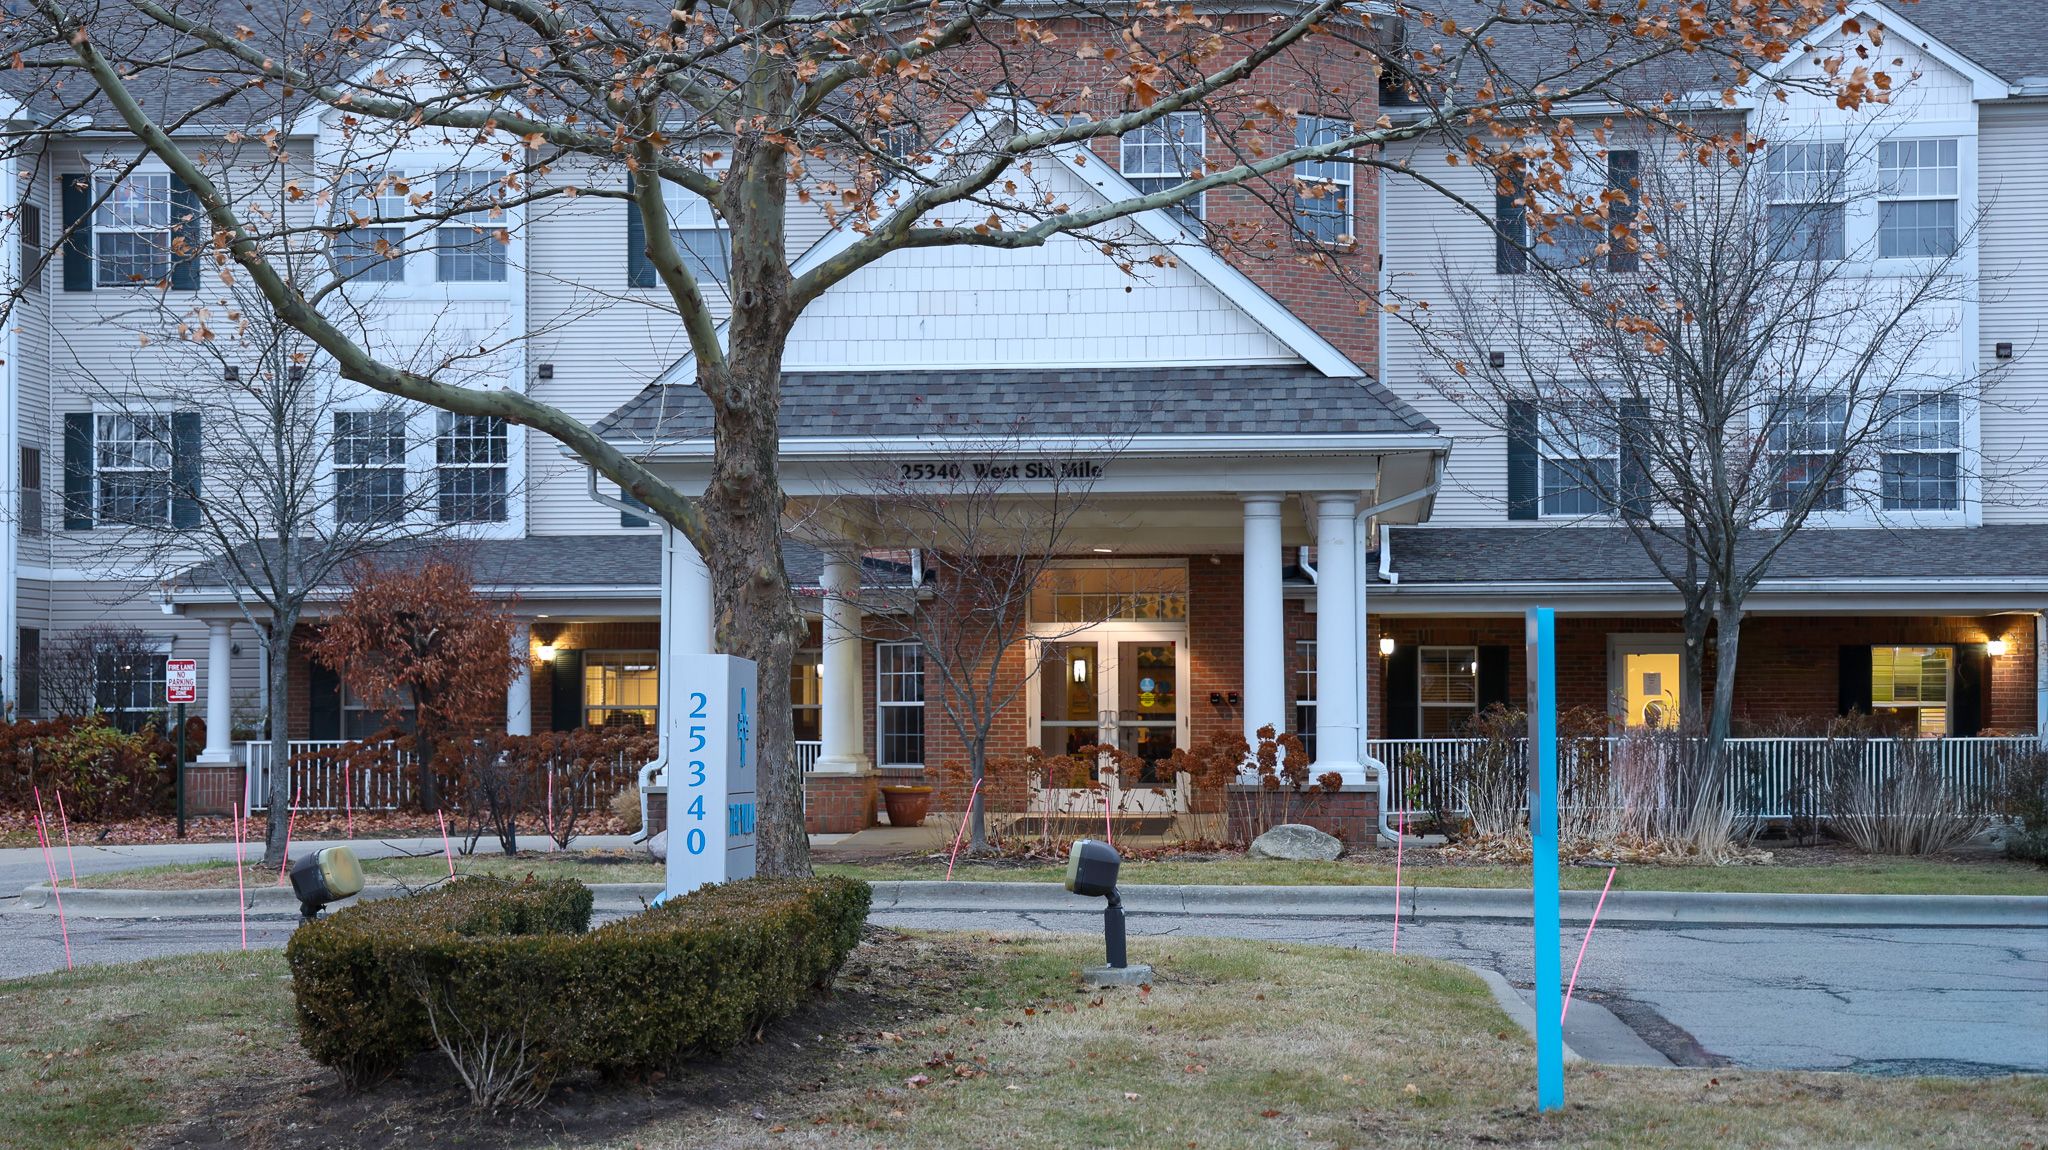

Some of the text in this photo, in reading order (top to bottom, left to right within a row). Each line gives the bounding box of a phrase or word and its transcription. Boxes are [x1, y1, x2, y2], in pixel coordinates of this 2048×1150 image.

[900, 461, 1102, 479] 25340 West Six Mile
